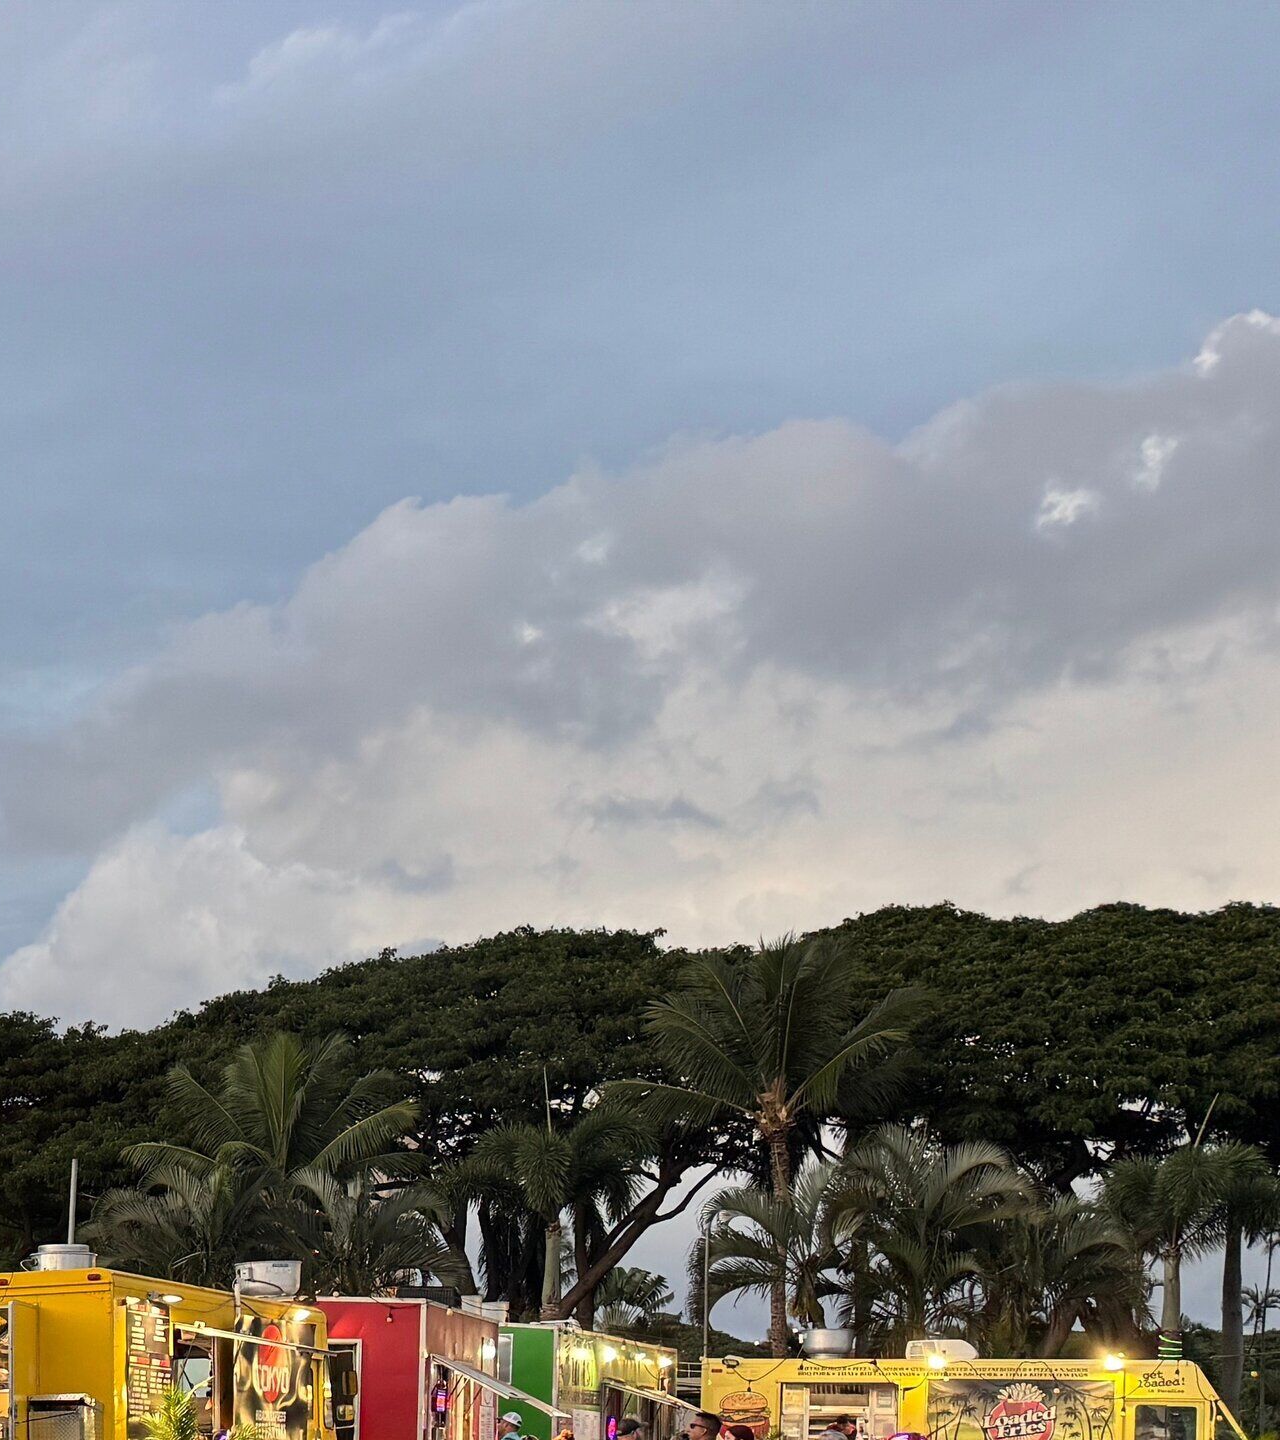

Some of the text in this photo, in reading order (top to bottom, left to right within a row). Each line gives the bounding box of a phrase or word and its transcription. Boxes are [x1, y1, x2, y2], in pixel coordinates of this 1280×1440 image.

[1139, 1377, 1185, 1387] loaded!
[1143, 1371, 1163, 1379] get
[983, 1405, 1057, 1428] Loaded
[997, 1420, 1046, 1438] Fries
